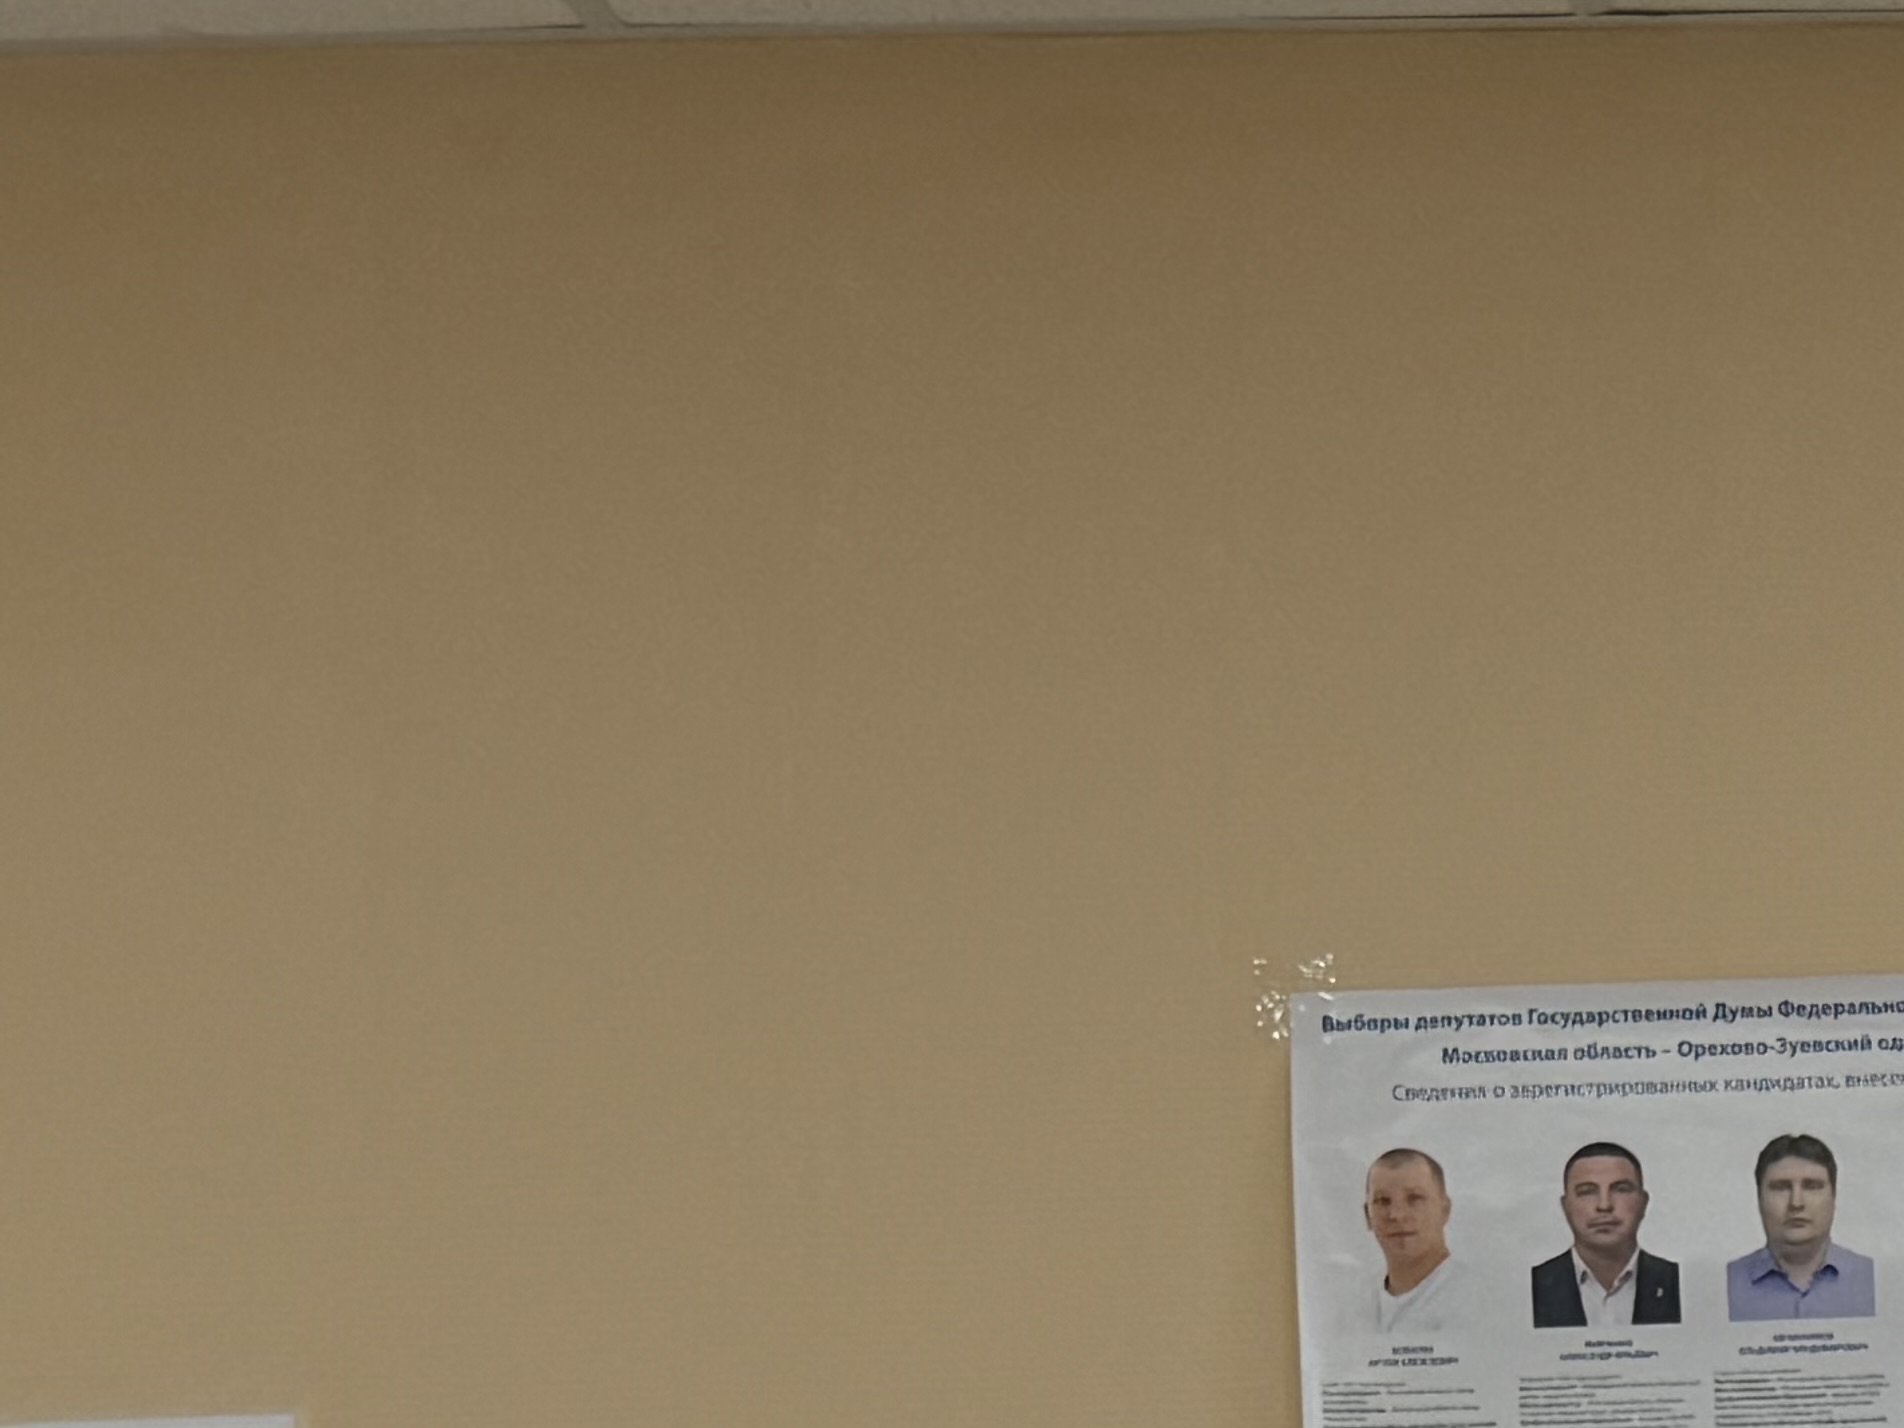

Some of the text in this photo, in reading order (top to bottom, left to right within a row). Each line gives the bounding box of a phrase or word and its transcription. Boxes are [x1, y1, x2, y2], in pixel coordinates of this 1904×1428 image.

[1321, 1013, 1410, 1034] Выборы
[1414, 1013, 1523, 1032] депутатов
[1527, 1003, 1708, 1029] Государственной
[1712, 1002, 1773, 1024] Думы
